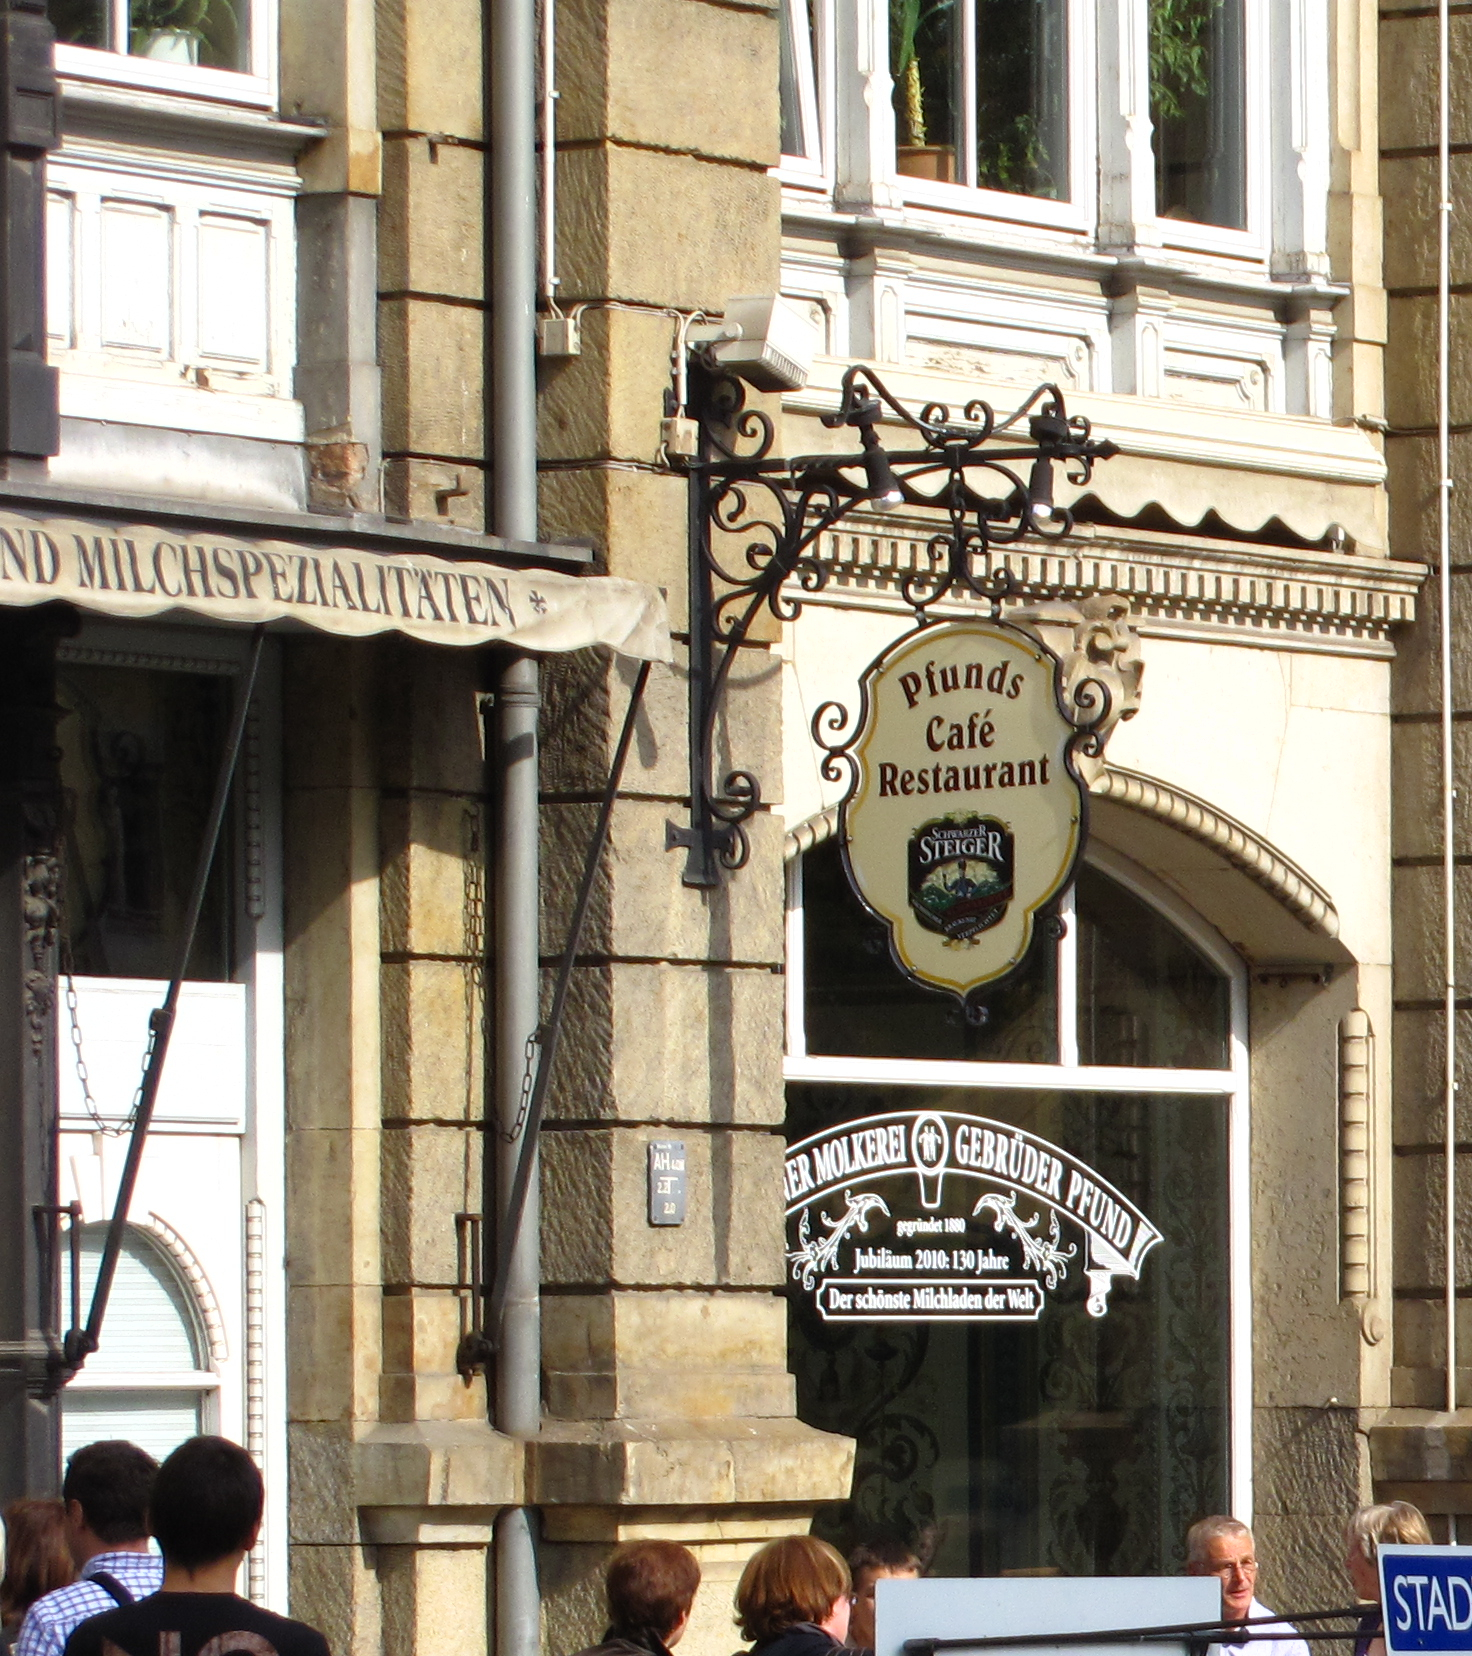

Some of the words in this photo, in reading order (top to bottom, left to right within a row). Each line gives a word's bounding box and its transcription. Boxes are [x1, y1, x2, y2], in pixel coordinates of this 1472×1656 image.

[73, 534, 516, 627] MILCHSPEZIALITÄTEN
[898, 660, 1025, 709] Pfunds
[926, 708, 995, 752] Café
[879, 754, 1050, 797] Restaurant
[919, 831, 1006, 864] STEIGER
[784, 1150, 812, 1200] ER
[813, 1125, 907, 1184] MOLKEREI
[955, 1125, 1064, 1200] GEBRÜDER
[1068, 1170, 1134, 1249] PFUND
[896, 1217, 942, 1236] gegründet
[854, 1248, 913, 1274] Jubiläum
[915, 1250, 950, 1270] 2010:
[952, 1250, 975, 1270] 130
[976, 1248, 1010, 1273] Jahre
[830, 1288, 854, 1310] Der
[855, 1286, 911, 1310] schönste
[913, 1286, 983, 1310] Milchladen
[984, 1286, 1006, 1310] der
[1007, 1286, 1035, 1309] Welt
